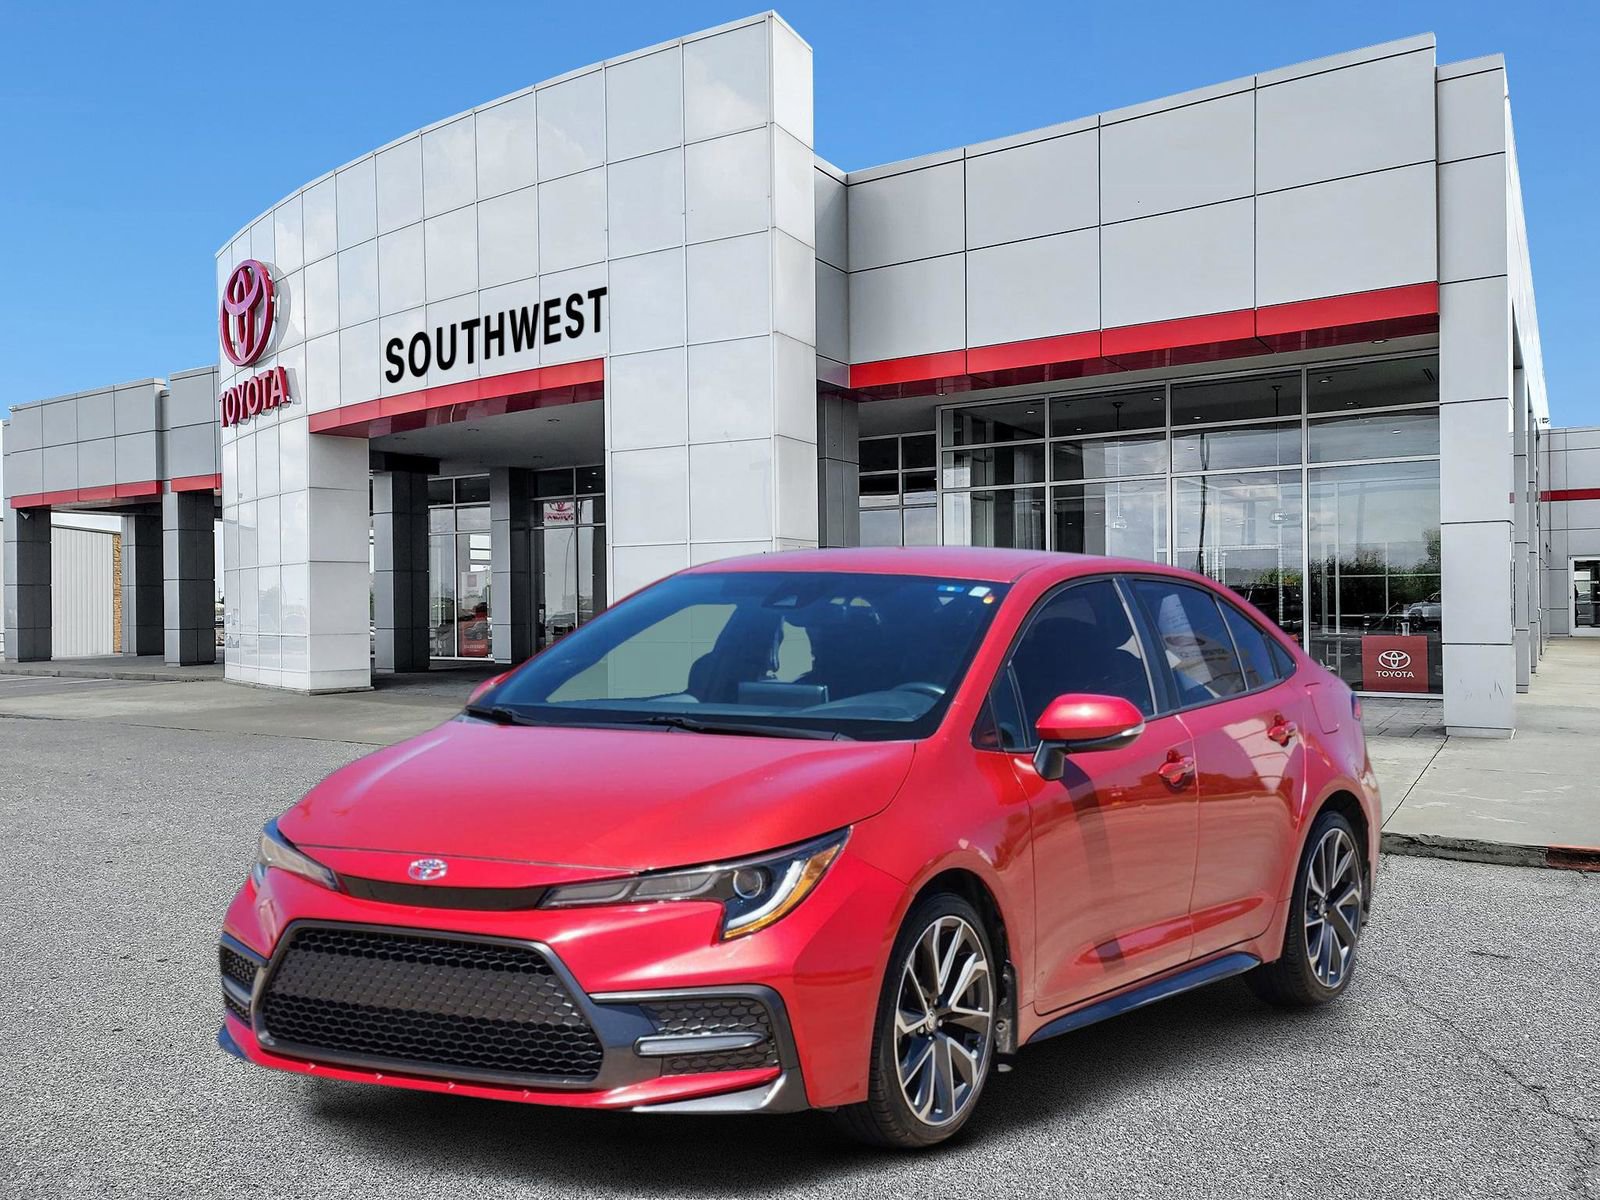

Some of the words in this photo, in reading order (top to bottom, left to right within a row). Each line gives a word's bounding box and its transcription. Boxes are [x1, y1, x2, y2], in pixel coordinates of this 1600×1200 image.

[385, 286, 608, 384] SOUTHWEST
[218, 366, 290, 428] TOYOTA
[1376, 670, 1415, 678] TOYOTA
